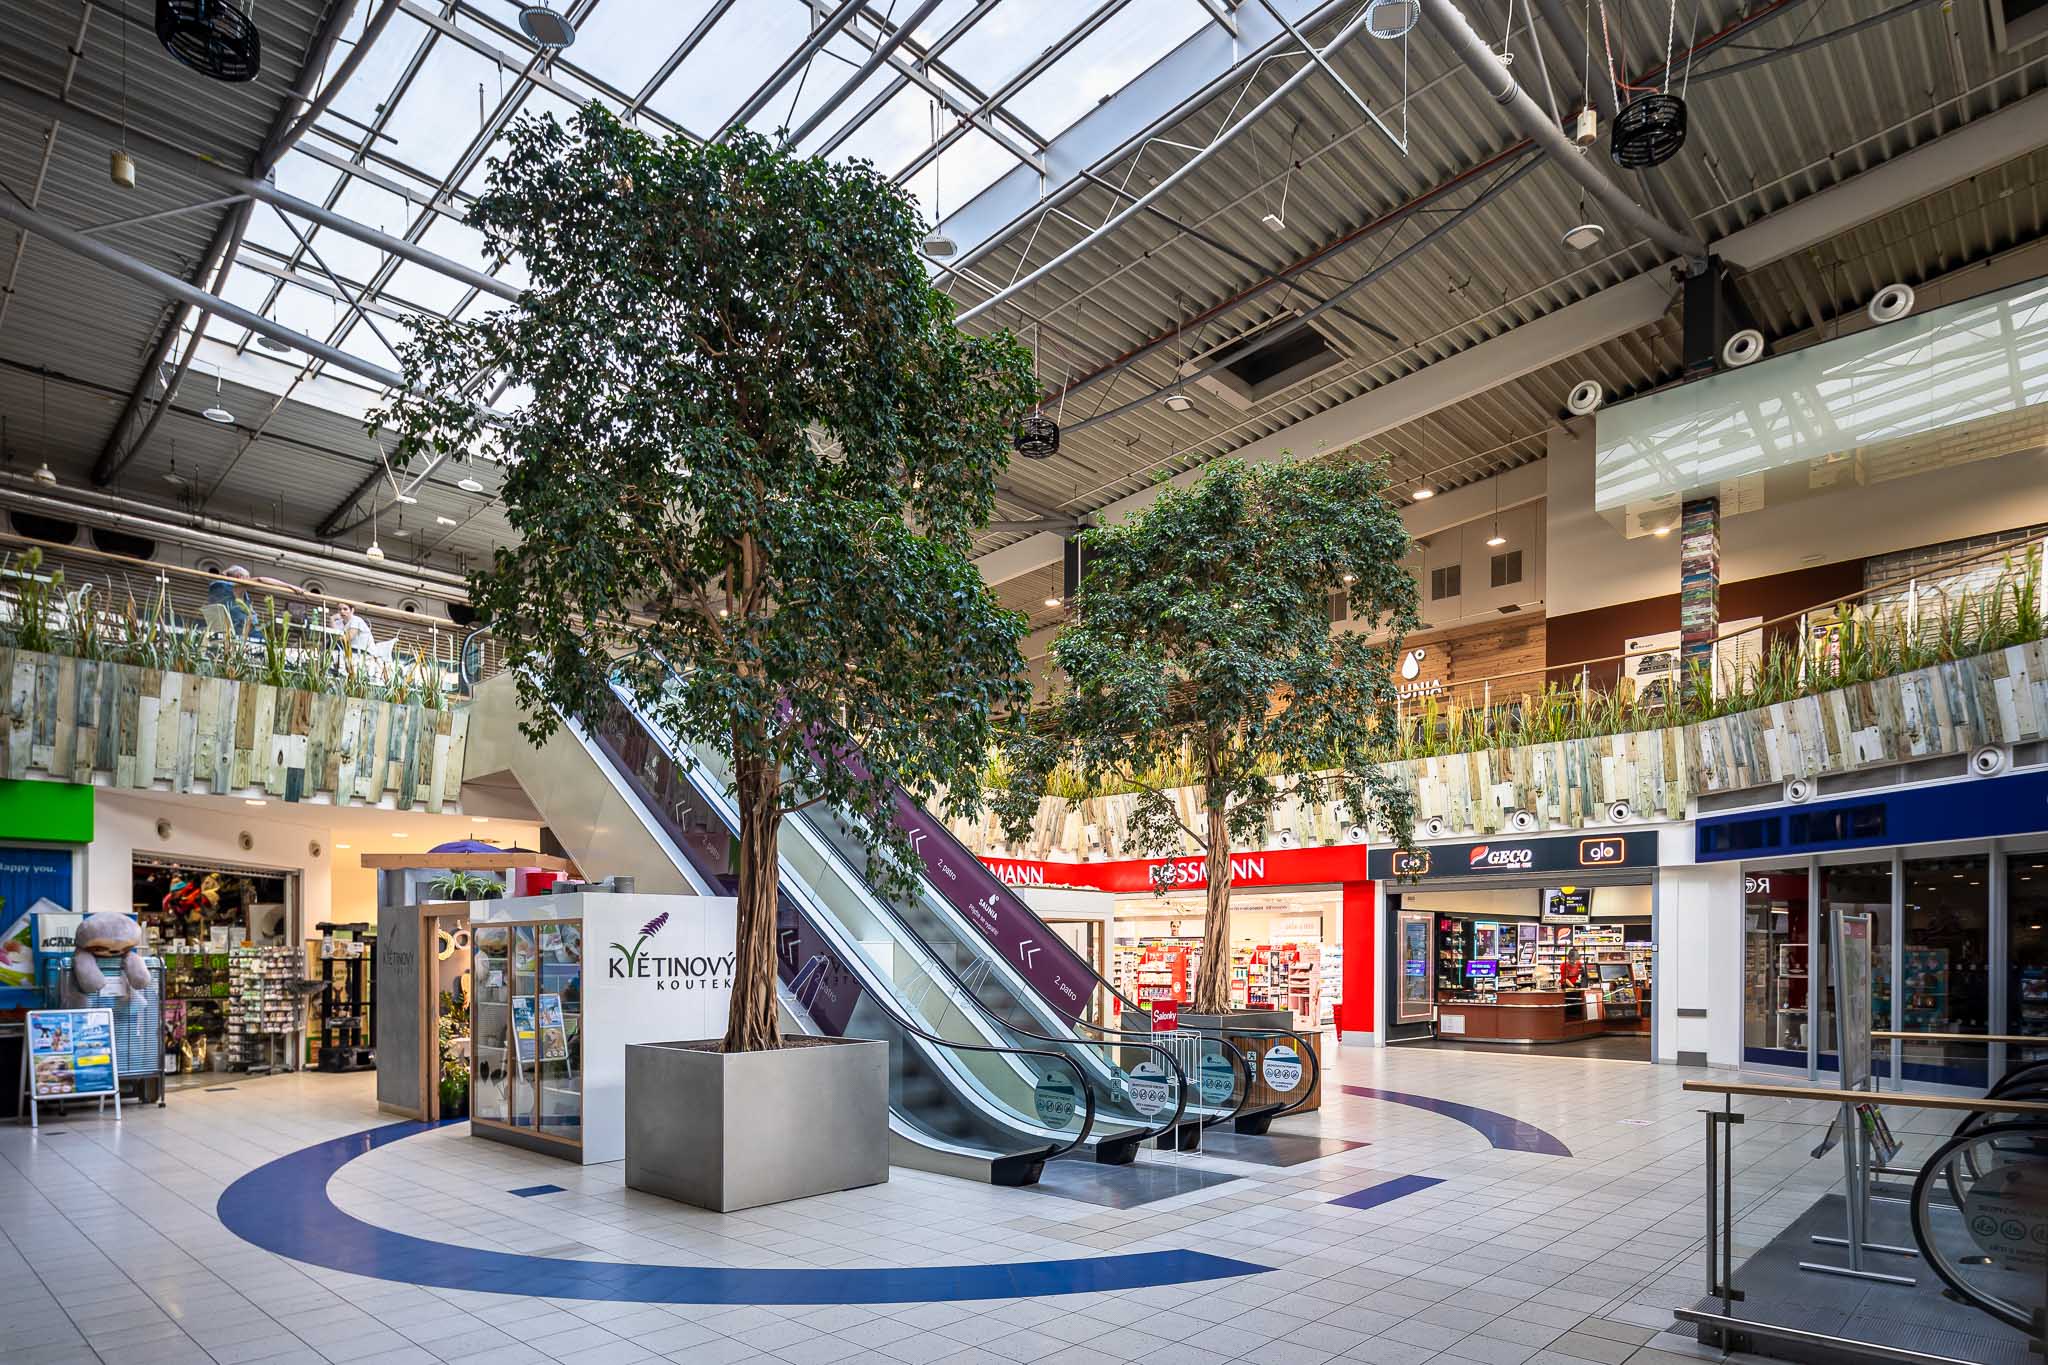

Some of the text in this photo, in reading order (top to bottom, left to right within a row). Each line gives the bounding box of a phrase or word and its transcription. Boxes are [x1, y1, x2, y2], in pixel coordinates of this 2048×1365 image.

[1394, 680, 1442, 700] UNIA
[1488, 849, 1532, 865] GECO
[1590, 842, 1614, 860] glo
[942, 864, 957, 881] patro
[984, 863, 1044, 885] MANN
[1148, 857, 1265, 885] ROSSNN
[979, 898, 998, 920] SAUNIA
[656, 978, 732, 991] KOUTEK
[1053, 975, 1077, 1001] 2. patro
[1153, 1009, 1177, 1023] Salonky
